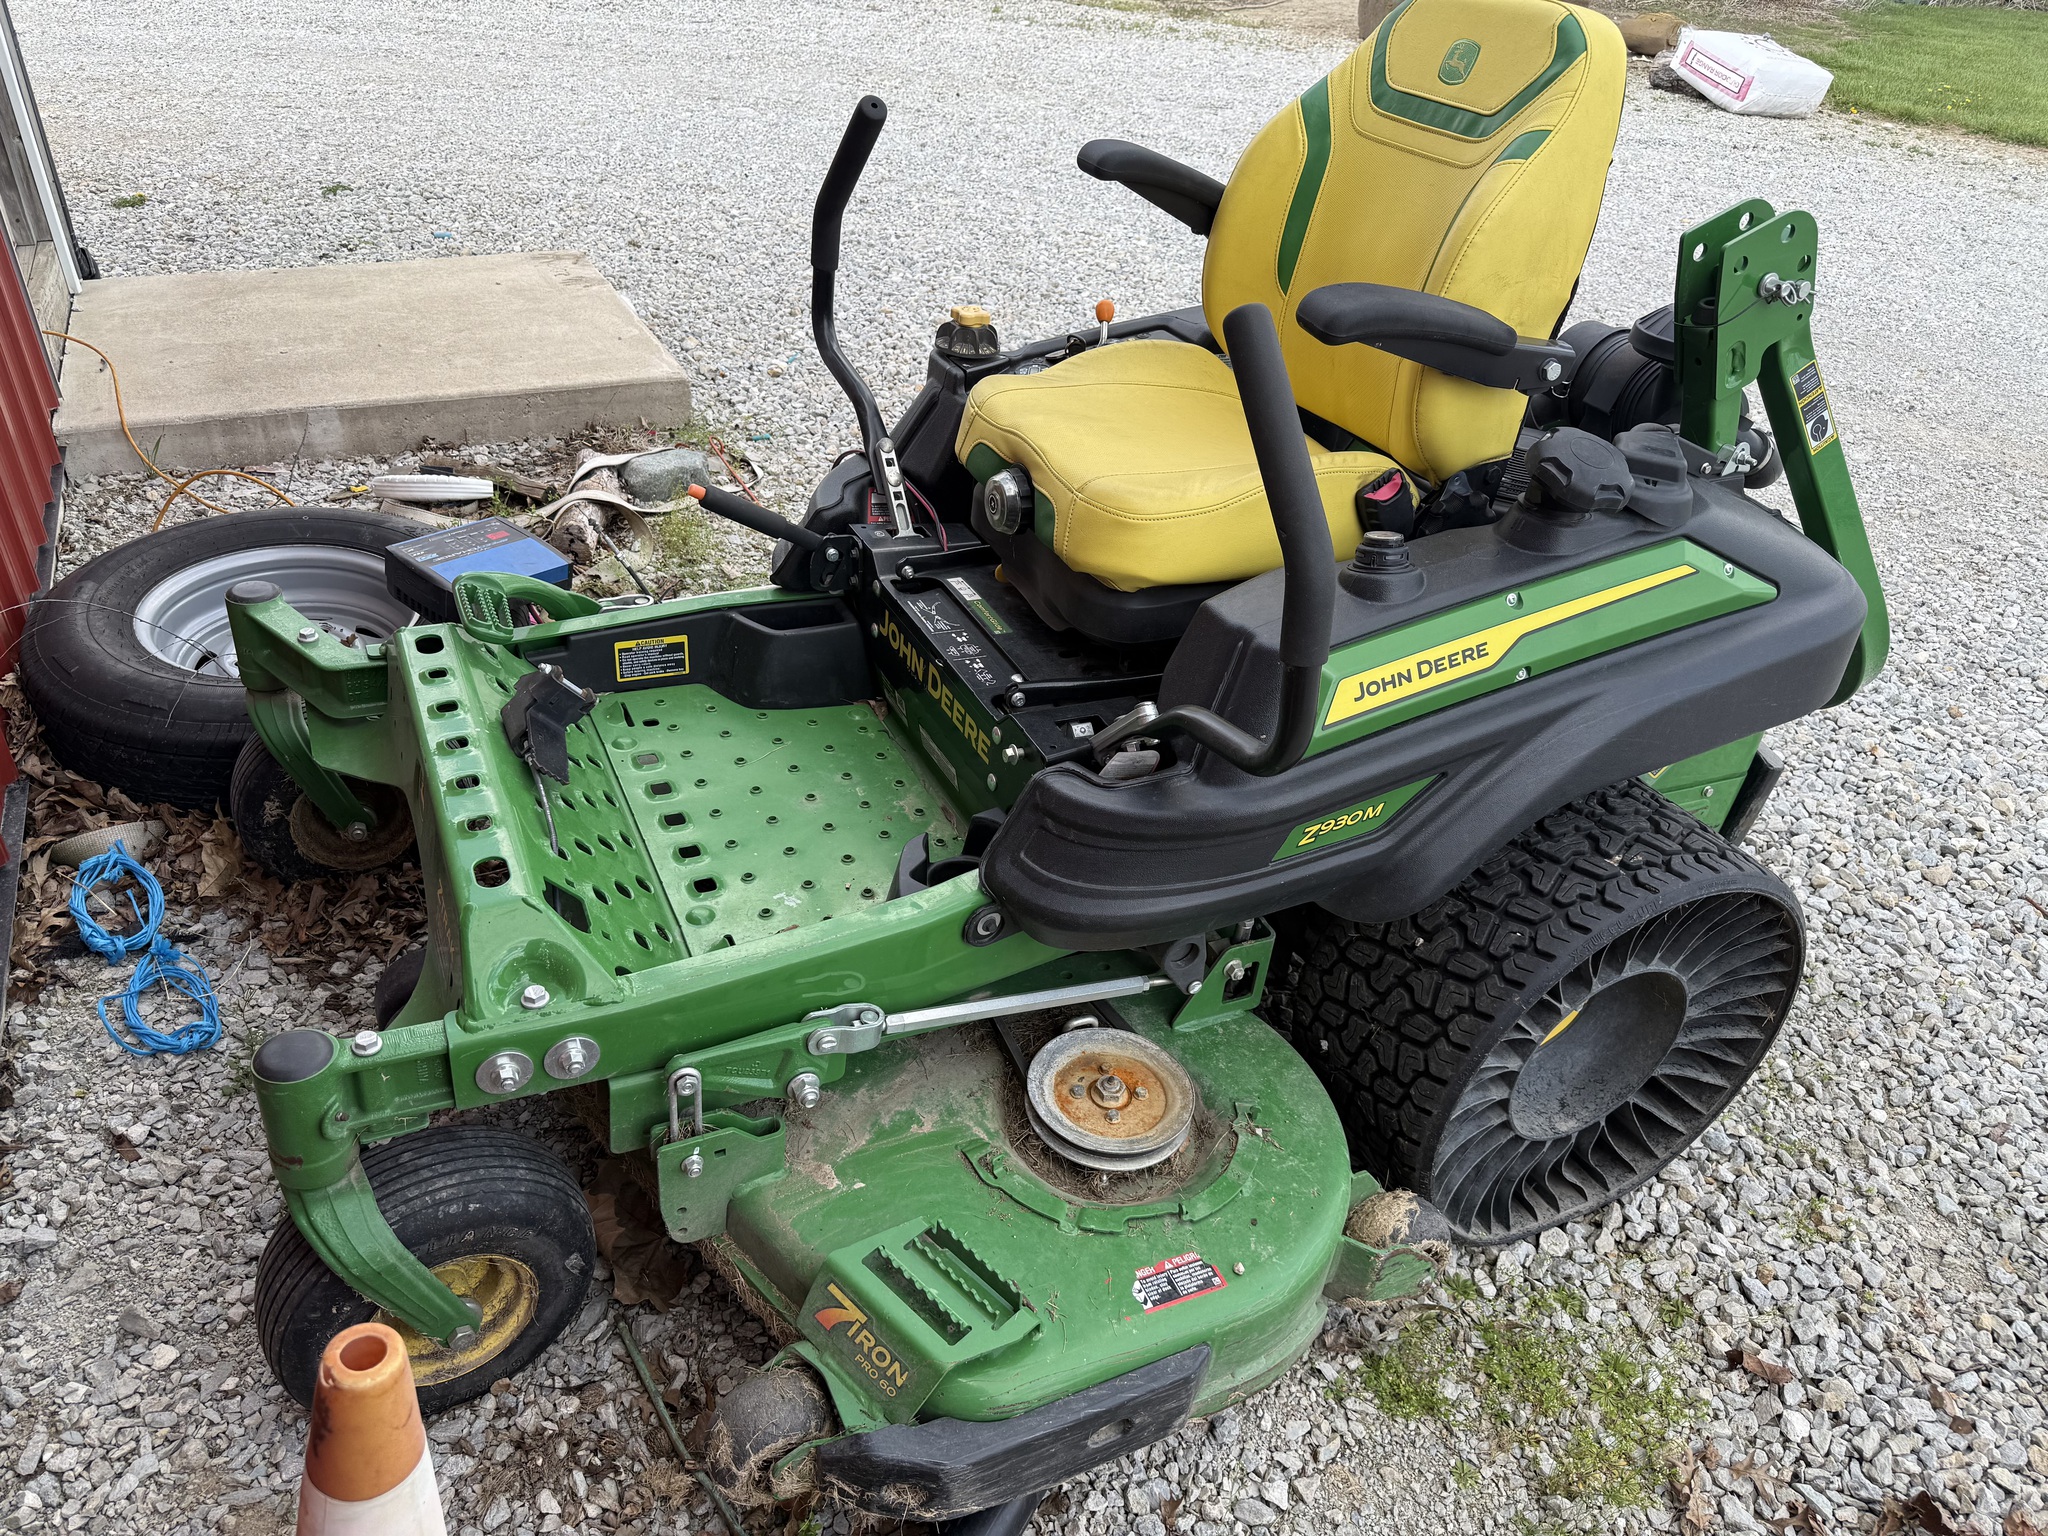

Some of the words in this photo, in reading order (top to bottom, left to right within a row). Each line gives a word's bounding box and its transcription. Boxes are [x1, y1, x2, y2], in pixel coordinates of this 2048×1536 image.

[1695, 58, 1716, 74] RANGE
[879, 609, 924, 682] JOHN
[928, 662, 992, 766] DEERE
[1354, 668, 1412, 702] JOHN
[1416, 642, 1490, 680] DEERE
[1298, 802, 1385, 846] Z930M
[854, 1354, 878, 1379] PRO
[880, 1380, 896, 1397] 60
